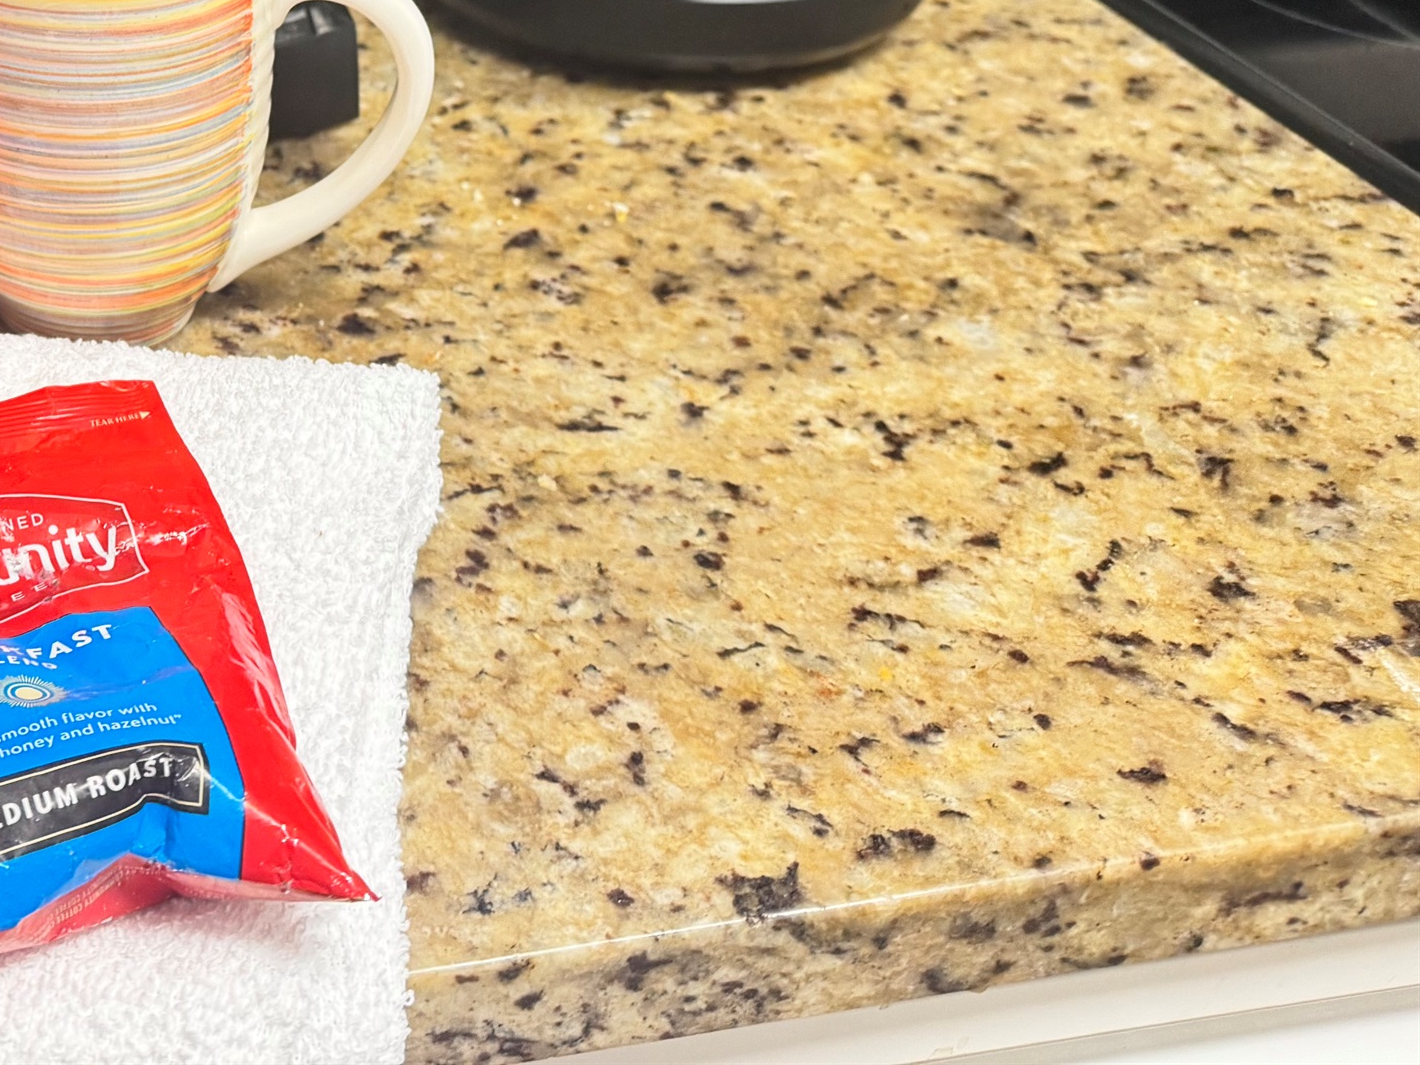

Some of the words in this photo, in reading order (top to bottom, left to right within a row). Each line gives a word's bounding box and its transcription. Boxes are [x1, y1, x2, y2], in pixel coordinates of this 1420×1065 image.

[90, 417, 114, 428] TEAR
[115, 412, 140, 424] HERE
[62, 708, 113, 724] flavor
[118, 702, 158, 715] with
[59, 723, 95, 742] and
[86, 757, 173, 799] ROAST
